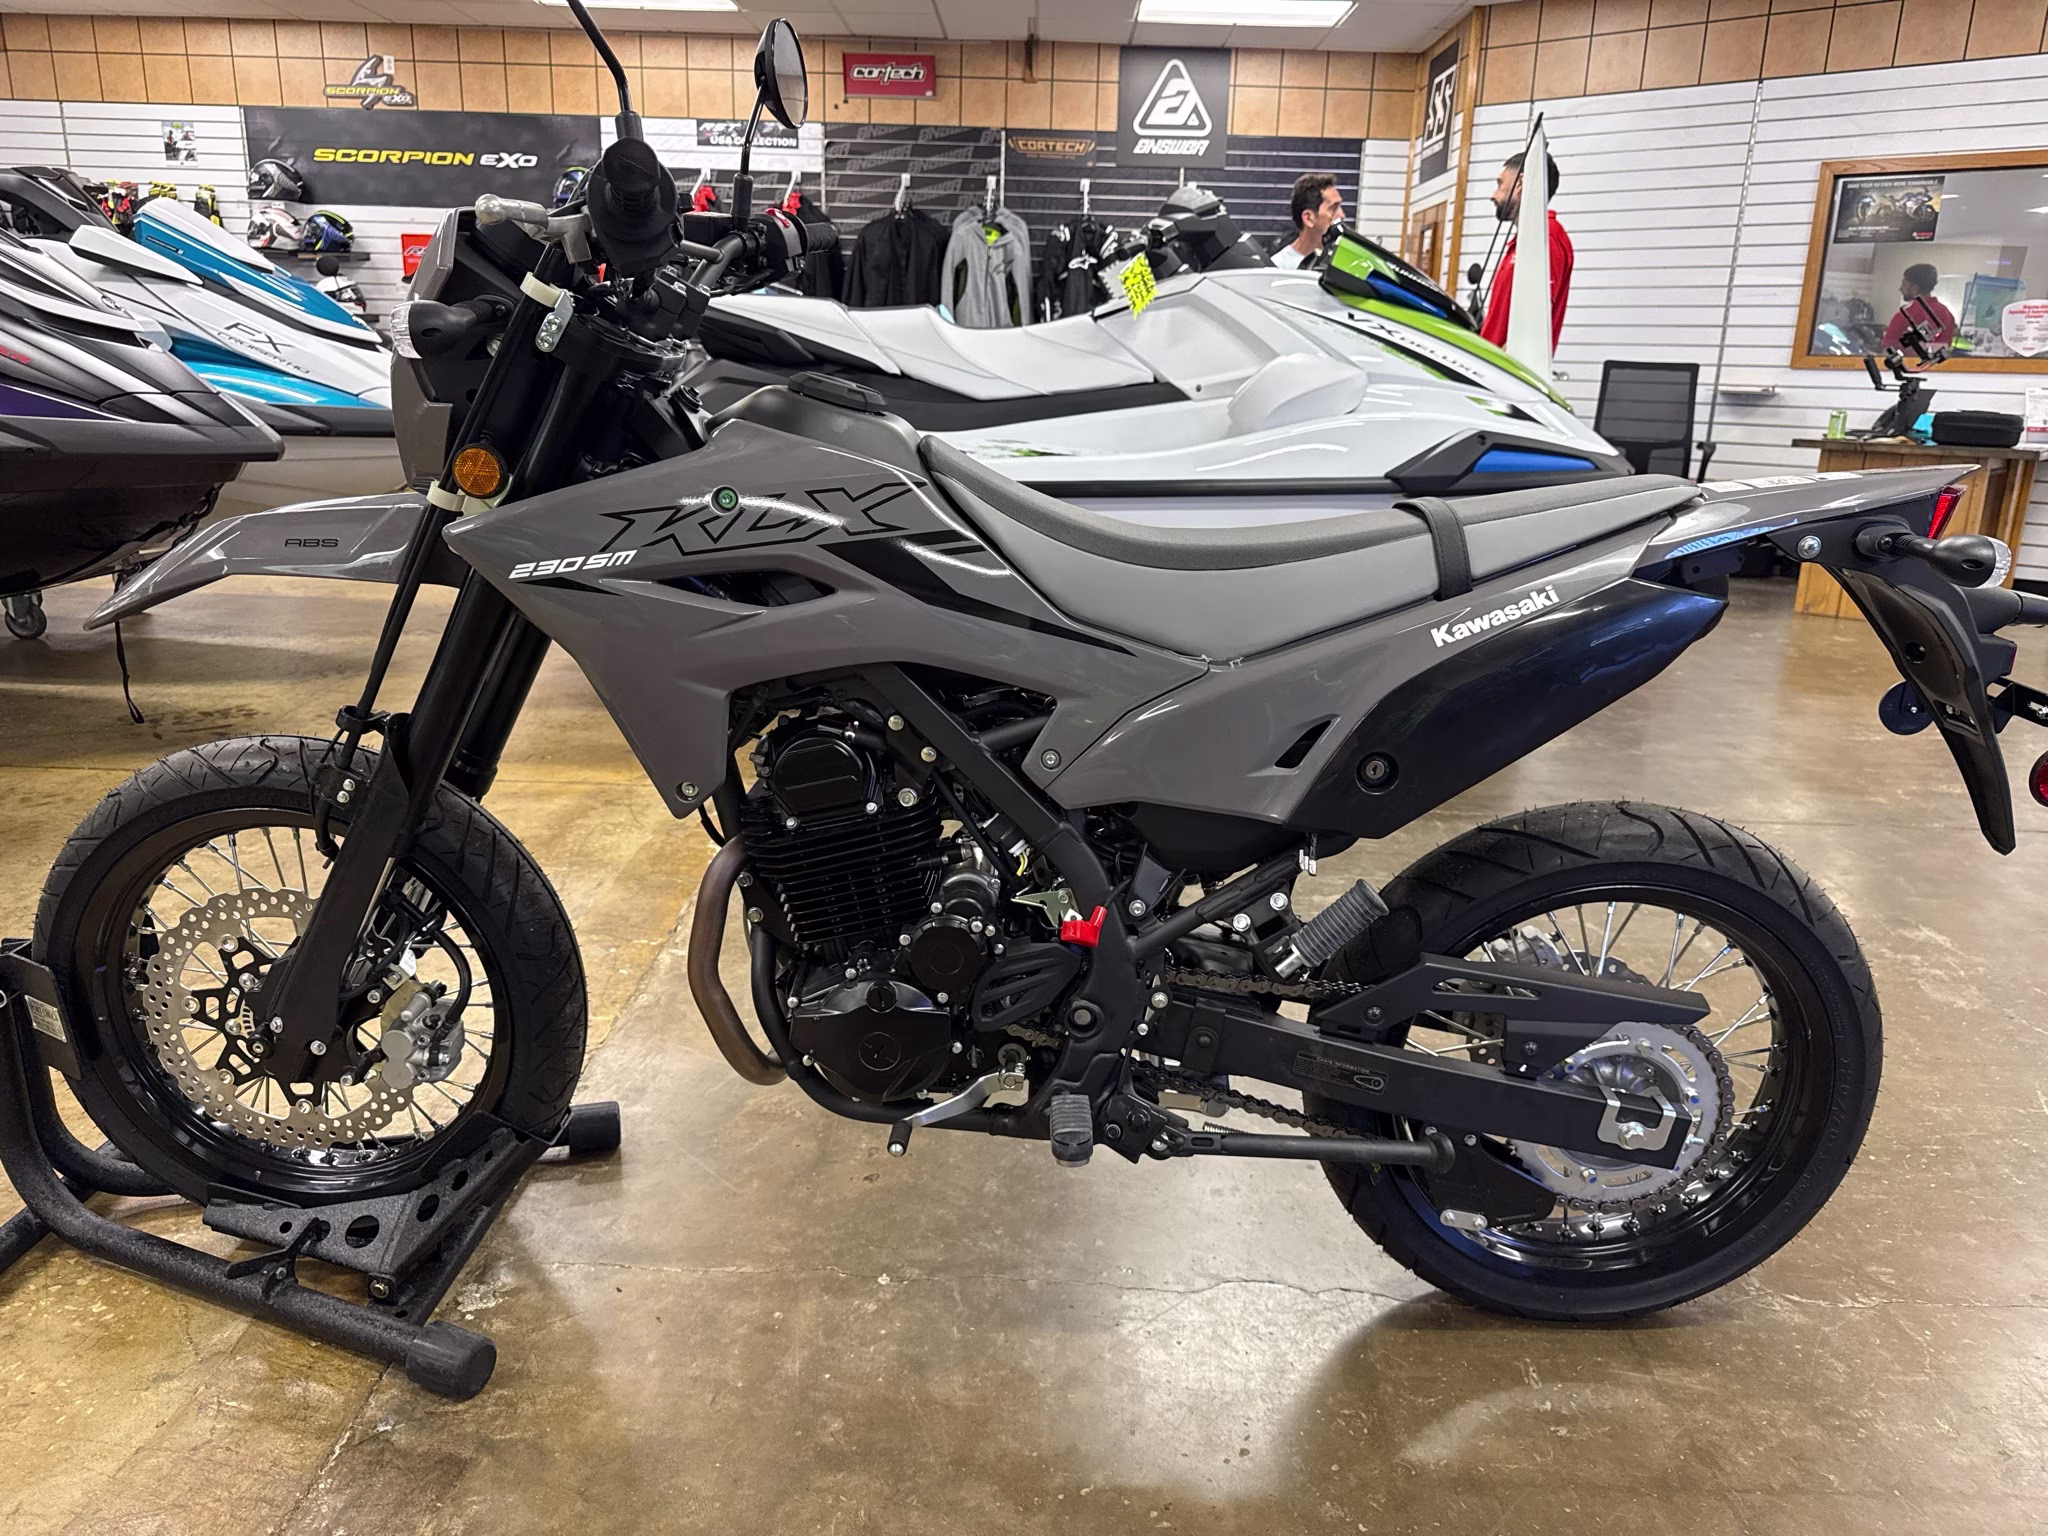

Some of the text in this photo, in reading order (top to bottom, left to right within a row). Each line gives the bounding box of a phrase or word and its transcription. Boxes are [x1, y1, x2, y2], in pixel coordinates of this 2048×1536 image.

[325, 86, 399, 96] SCORPION
[709, 136, 732, 146] USA
[1018, 139, 1086, 153] CORTECH
[313, 148, 475, 166] SCORPION
[1347, 312, 1401, 338] VX
[224, 322, 295, 354] FX
[284, 538, 339, 548] ABS
[508, 550, 638, 579] 230SM
[1430, 584, 1561, 648] Kawasaki
[1334, 1061, 1370, 1075] INFORMATION
